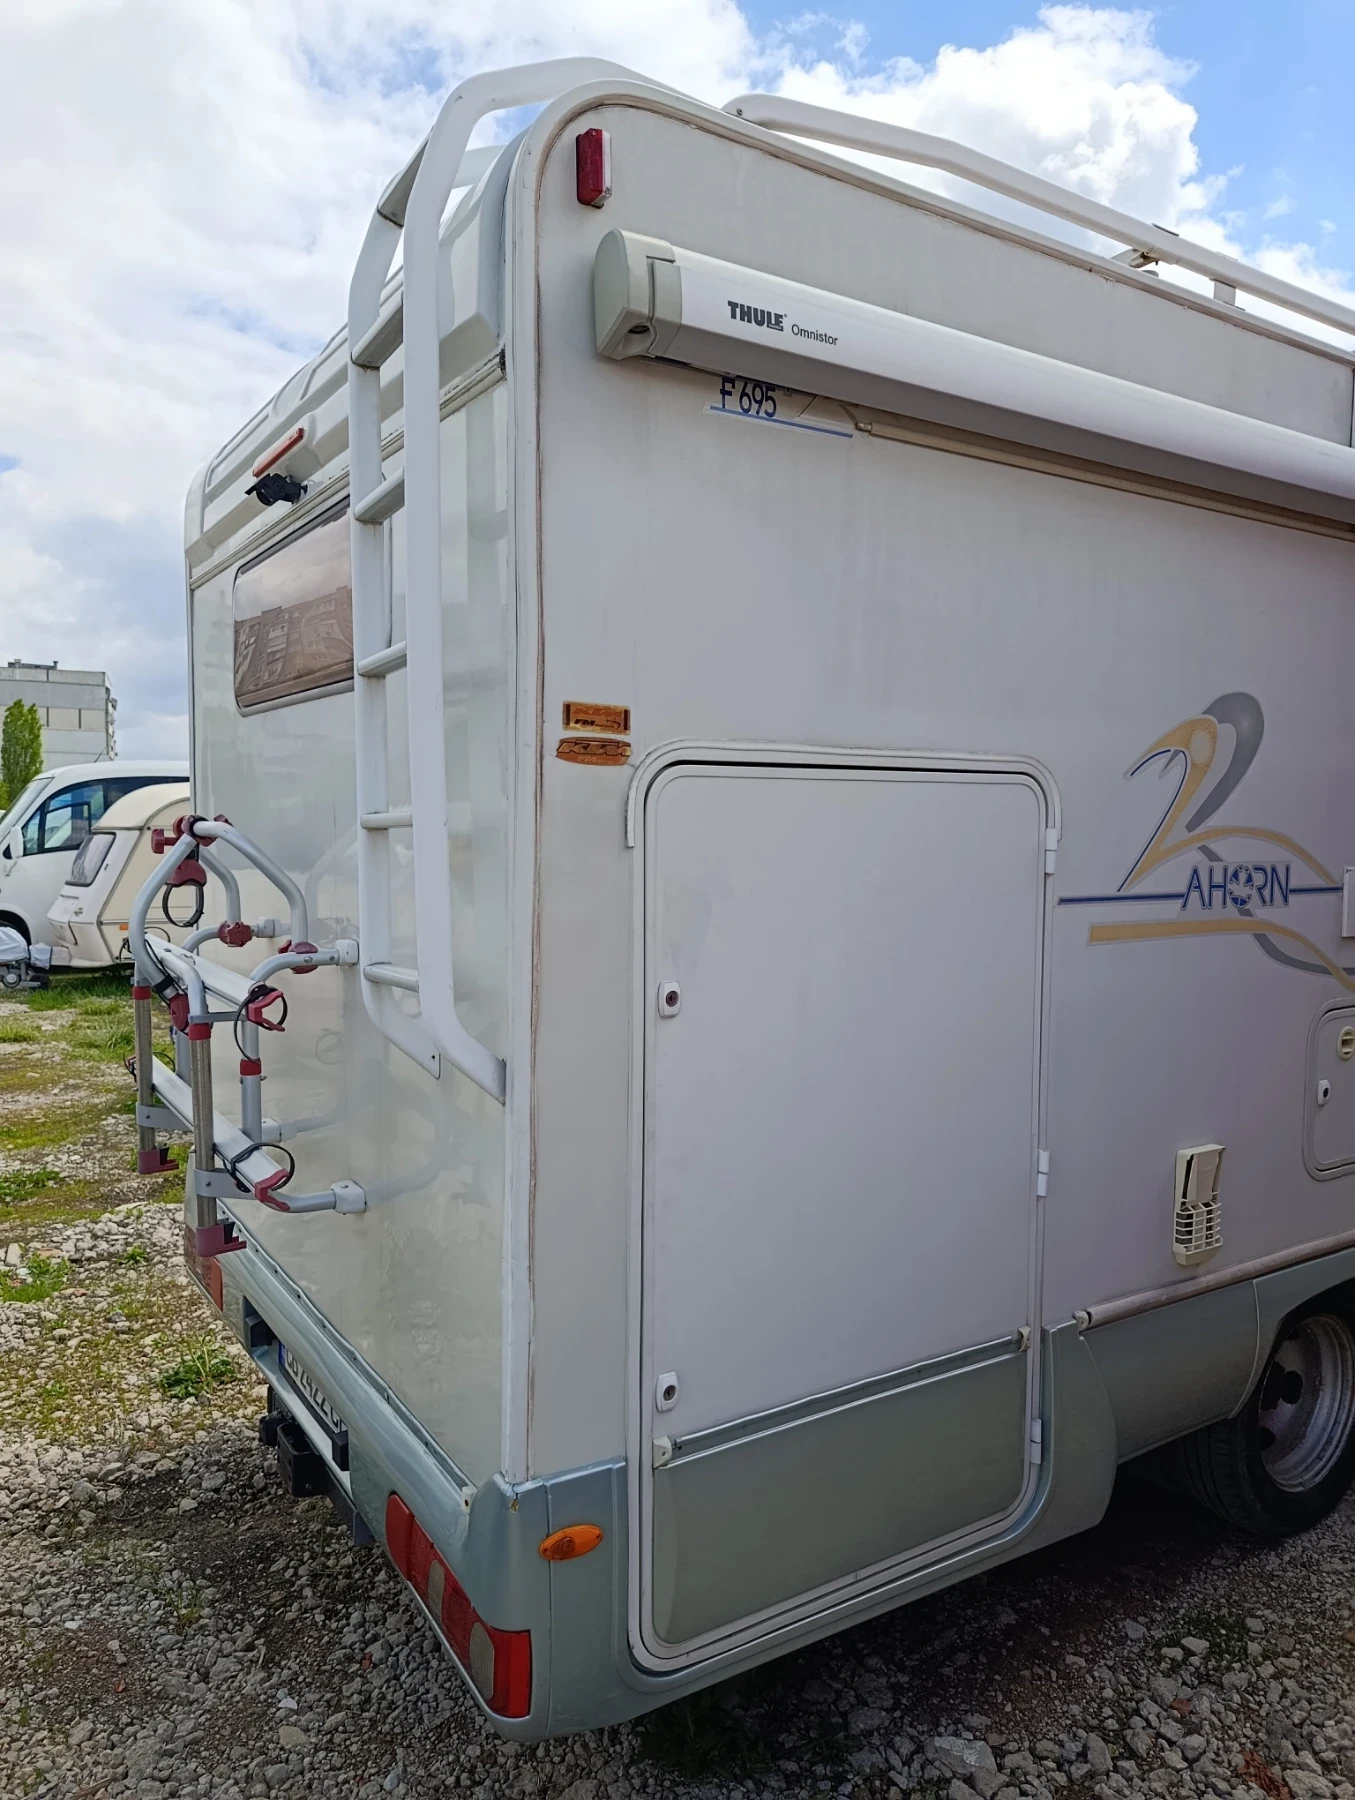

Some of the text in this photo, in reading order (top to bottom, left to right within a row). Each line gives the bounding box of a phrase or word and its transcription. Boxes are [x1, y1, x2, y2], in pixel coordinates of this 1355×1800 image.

[727, 300, 838, 346] THULE Omnistor
[738, 381, 777, 418] 695
[1180, 864, 1291, 910] AHORN
